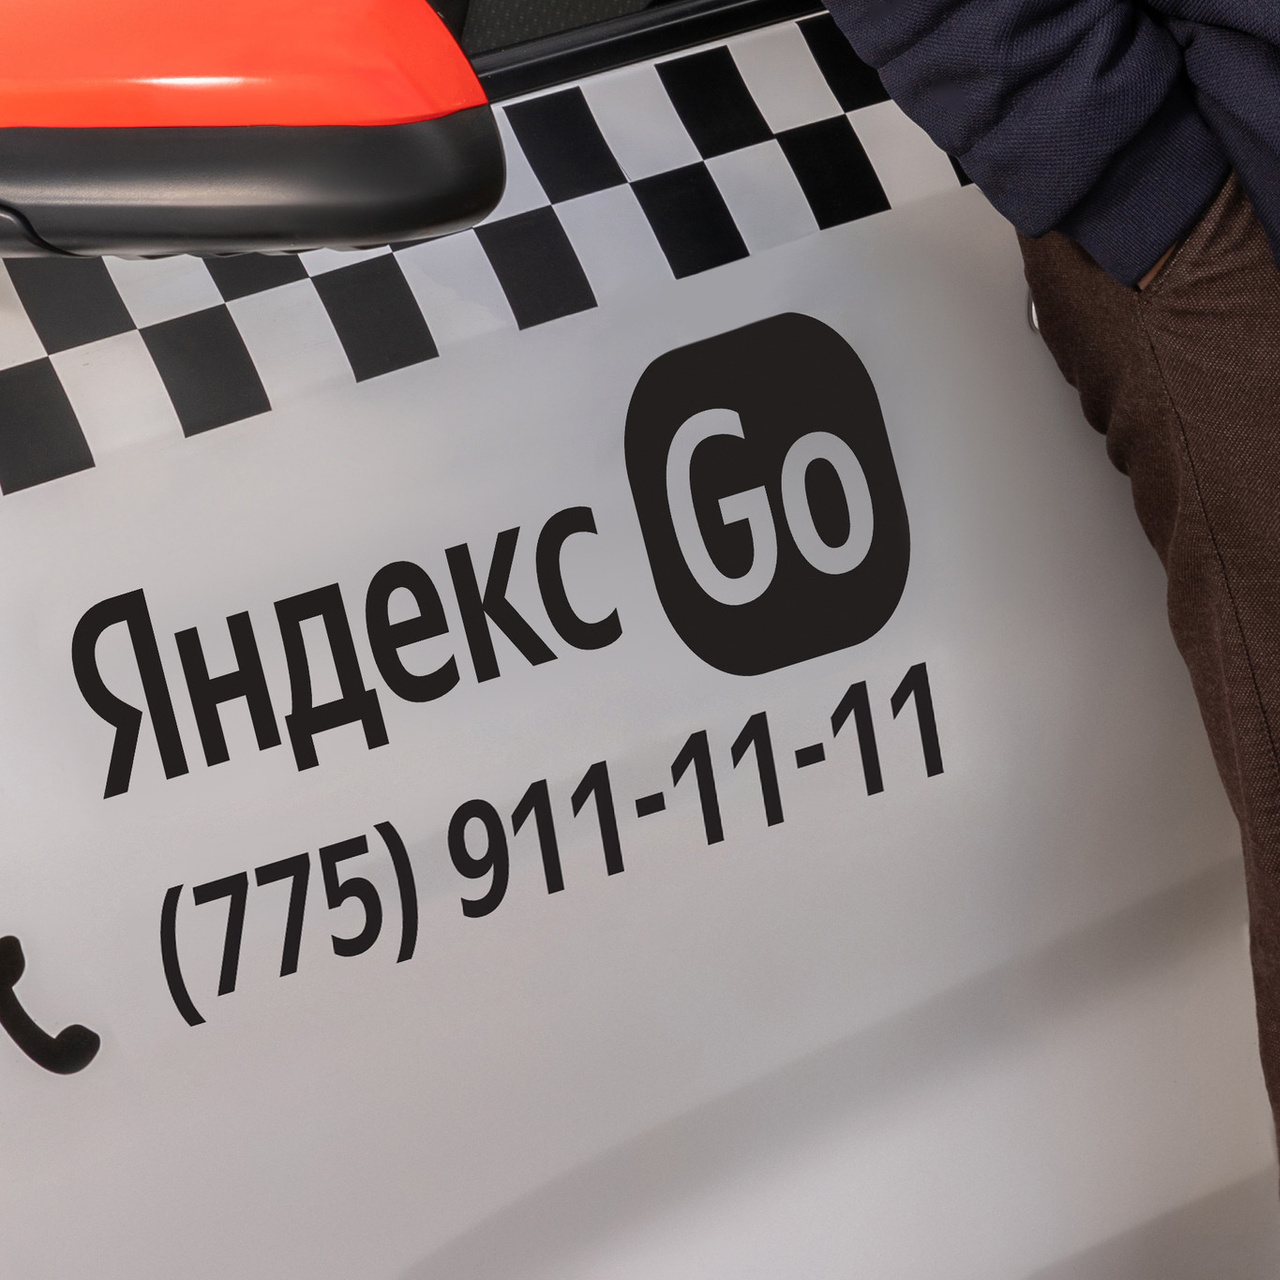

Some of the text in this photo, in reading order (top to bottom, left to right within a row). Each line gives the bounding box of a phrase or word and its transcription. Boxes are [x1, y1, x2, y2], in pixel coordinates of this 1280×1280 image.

[72, 409, 873, 799] Яндекс Go
[160, 662, 944, 1026] (775) 911-11-11
